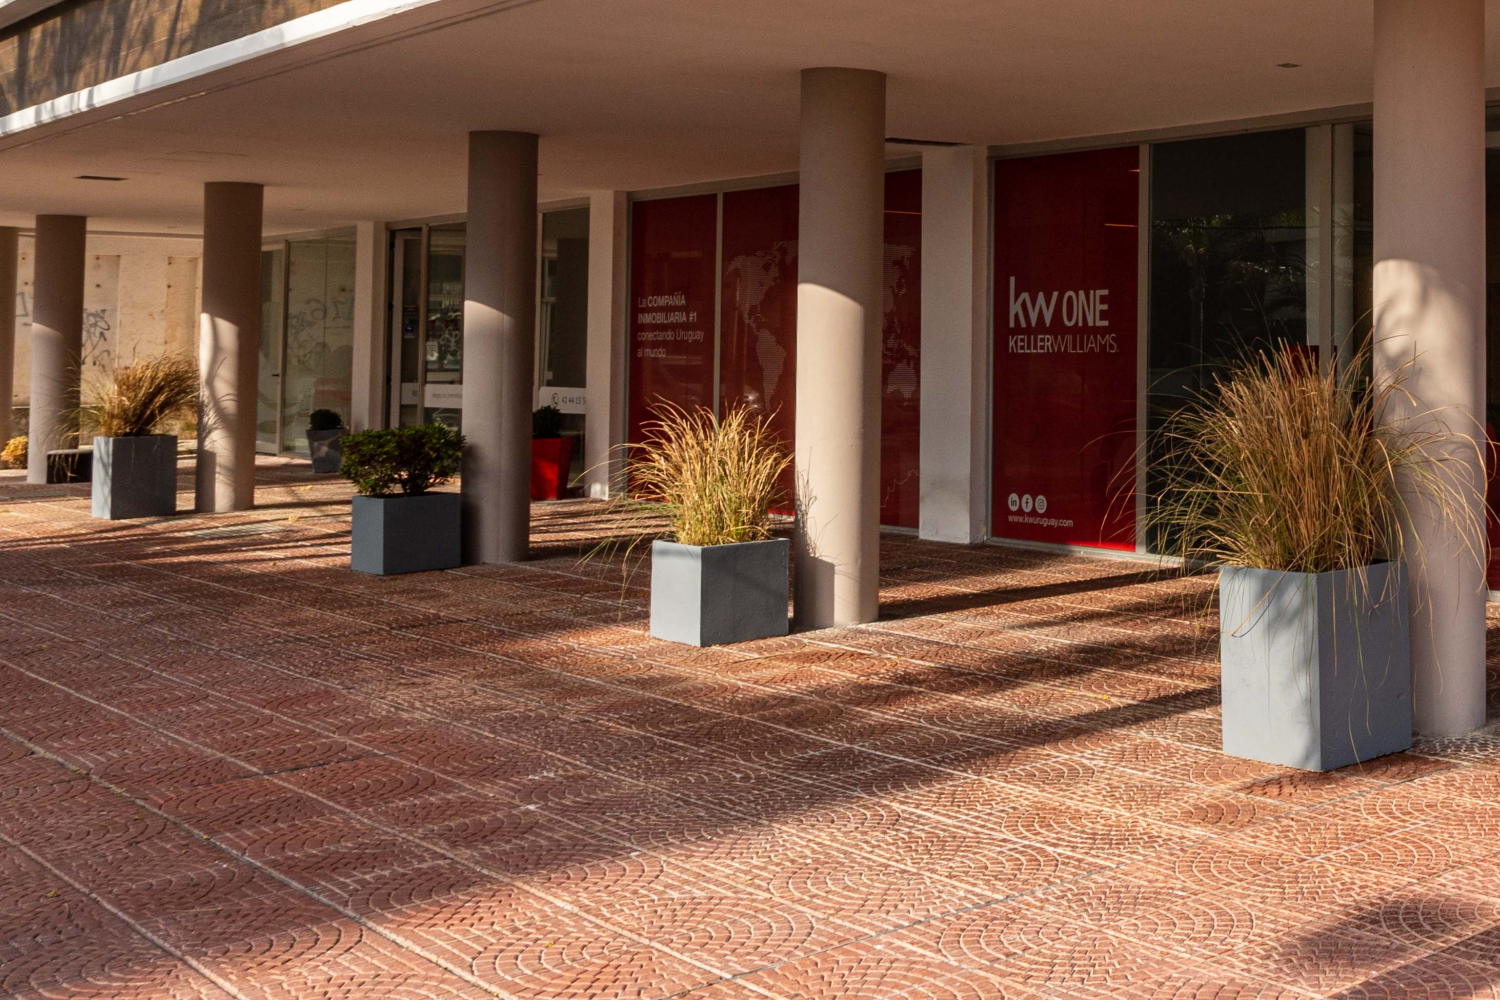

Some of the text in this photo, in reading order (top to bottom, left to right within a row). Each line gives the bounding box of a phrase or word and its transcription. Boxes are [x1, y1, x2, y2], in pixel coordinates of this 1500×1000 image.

[638, 291, 686, 308] La COMPAÑÍA
[1062, 289, 1109, 327] ONE
[638, 311, 697, 324] INMOBILIARIA #1
[638, 329, 704, 342] conectando Uruguay
[1009, 334, 1117, 353] KELLERWILLIAMS
[644, 346, 666, 358] mundo
[1008, 514, 1074, 528] www.kwuruguay.com
